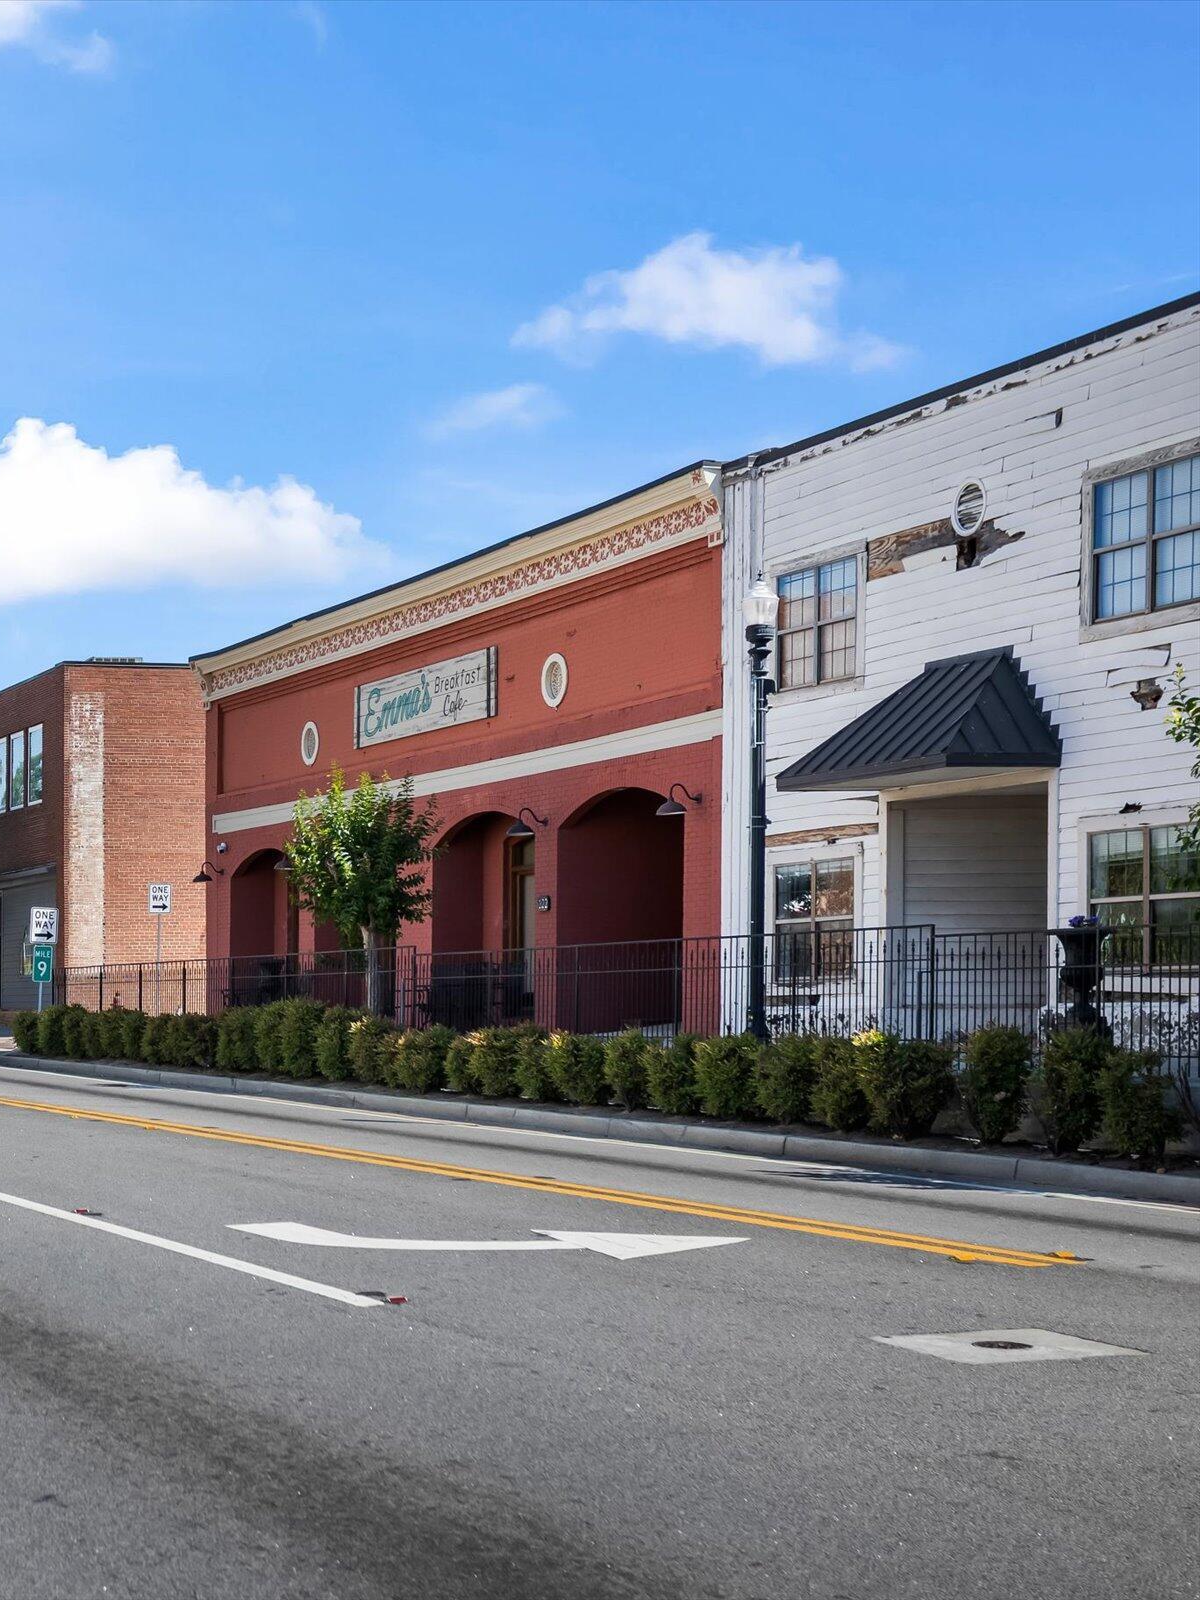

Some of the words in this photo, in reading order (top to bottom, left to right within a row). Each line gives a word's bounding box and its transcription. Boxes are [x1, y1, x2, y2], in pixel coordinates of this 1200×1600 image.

[434, 664, 481, 694] Breakfast
[364, 673, 432, 737] Emma's
[443, 690, 468, 721] Cafe
[35, 910, 55, 920] ONE
[35, 920, 55, 929] WAY
[35, 950, 51, 958] MILE
[37, 961, 47, 978] 9
